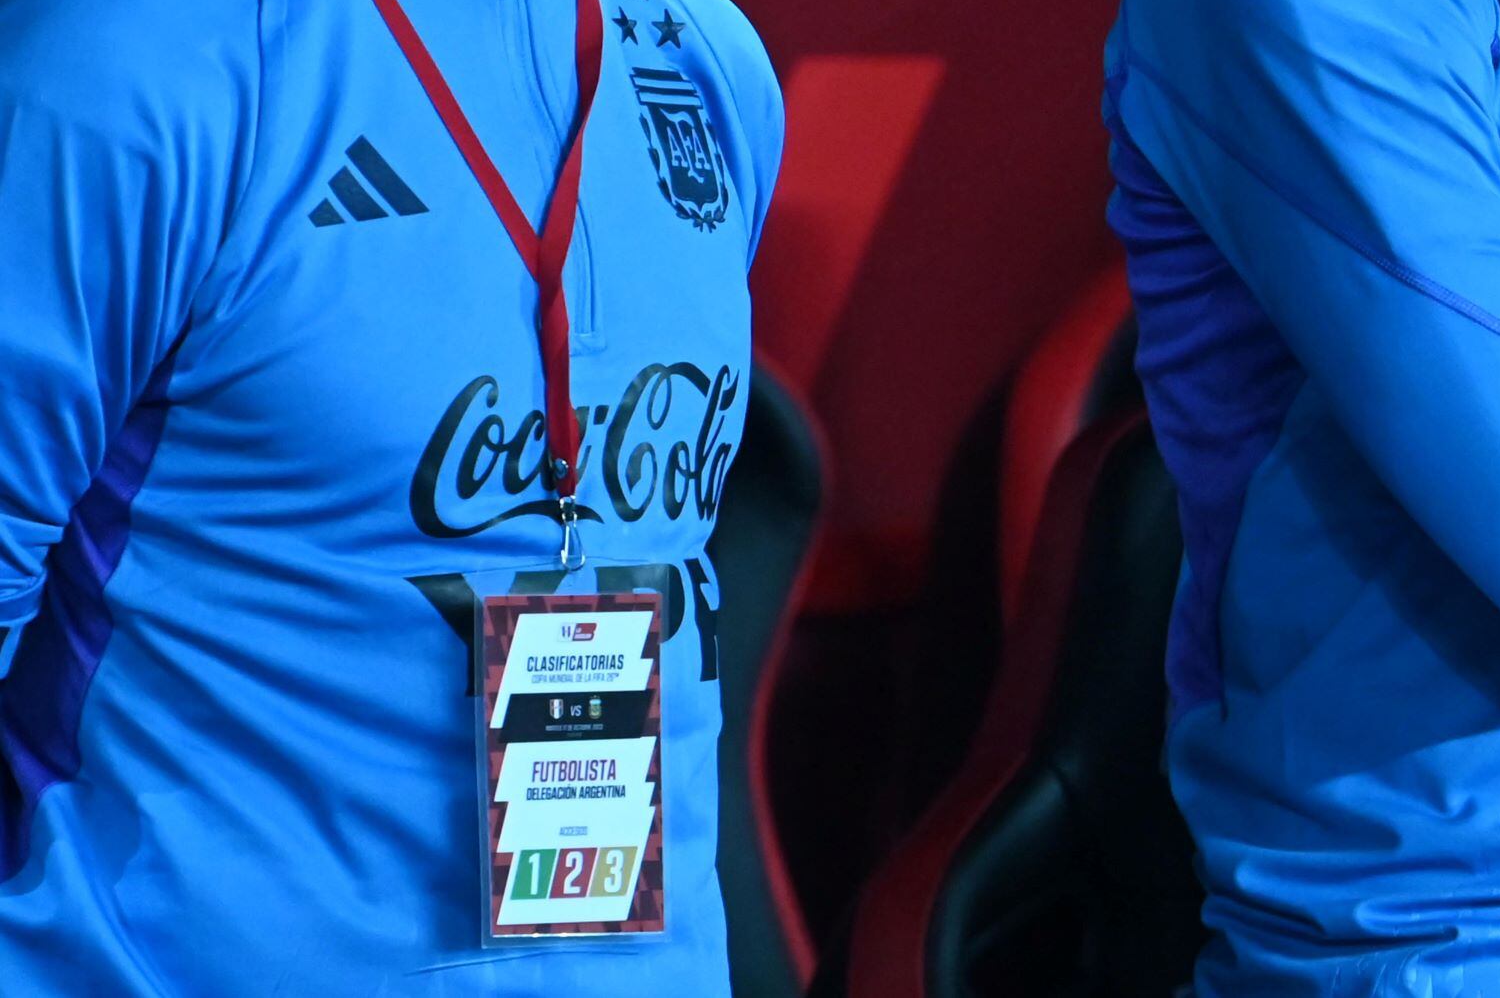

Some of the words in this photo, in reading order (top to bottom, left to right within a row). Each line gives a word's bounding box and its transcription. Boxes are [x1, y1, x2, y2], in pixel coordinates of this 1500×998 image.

[660, 107, 711, 184] AFA
[527, 655, 624, 672] CLASIFICATORIAS
[570, 704, 582, 717] VS
[532, 759, 616, 782] FUTBOLISTA
[526, 784, 577, 801] DELEGACIÓN
[579, 785, 625, 799] ARGENTINA
[528, 852, 540, 895] 1
[563, 851, 583, 894] 2
[604, 849, 624, 893] 3
